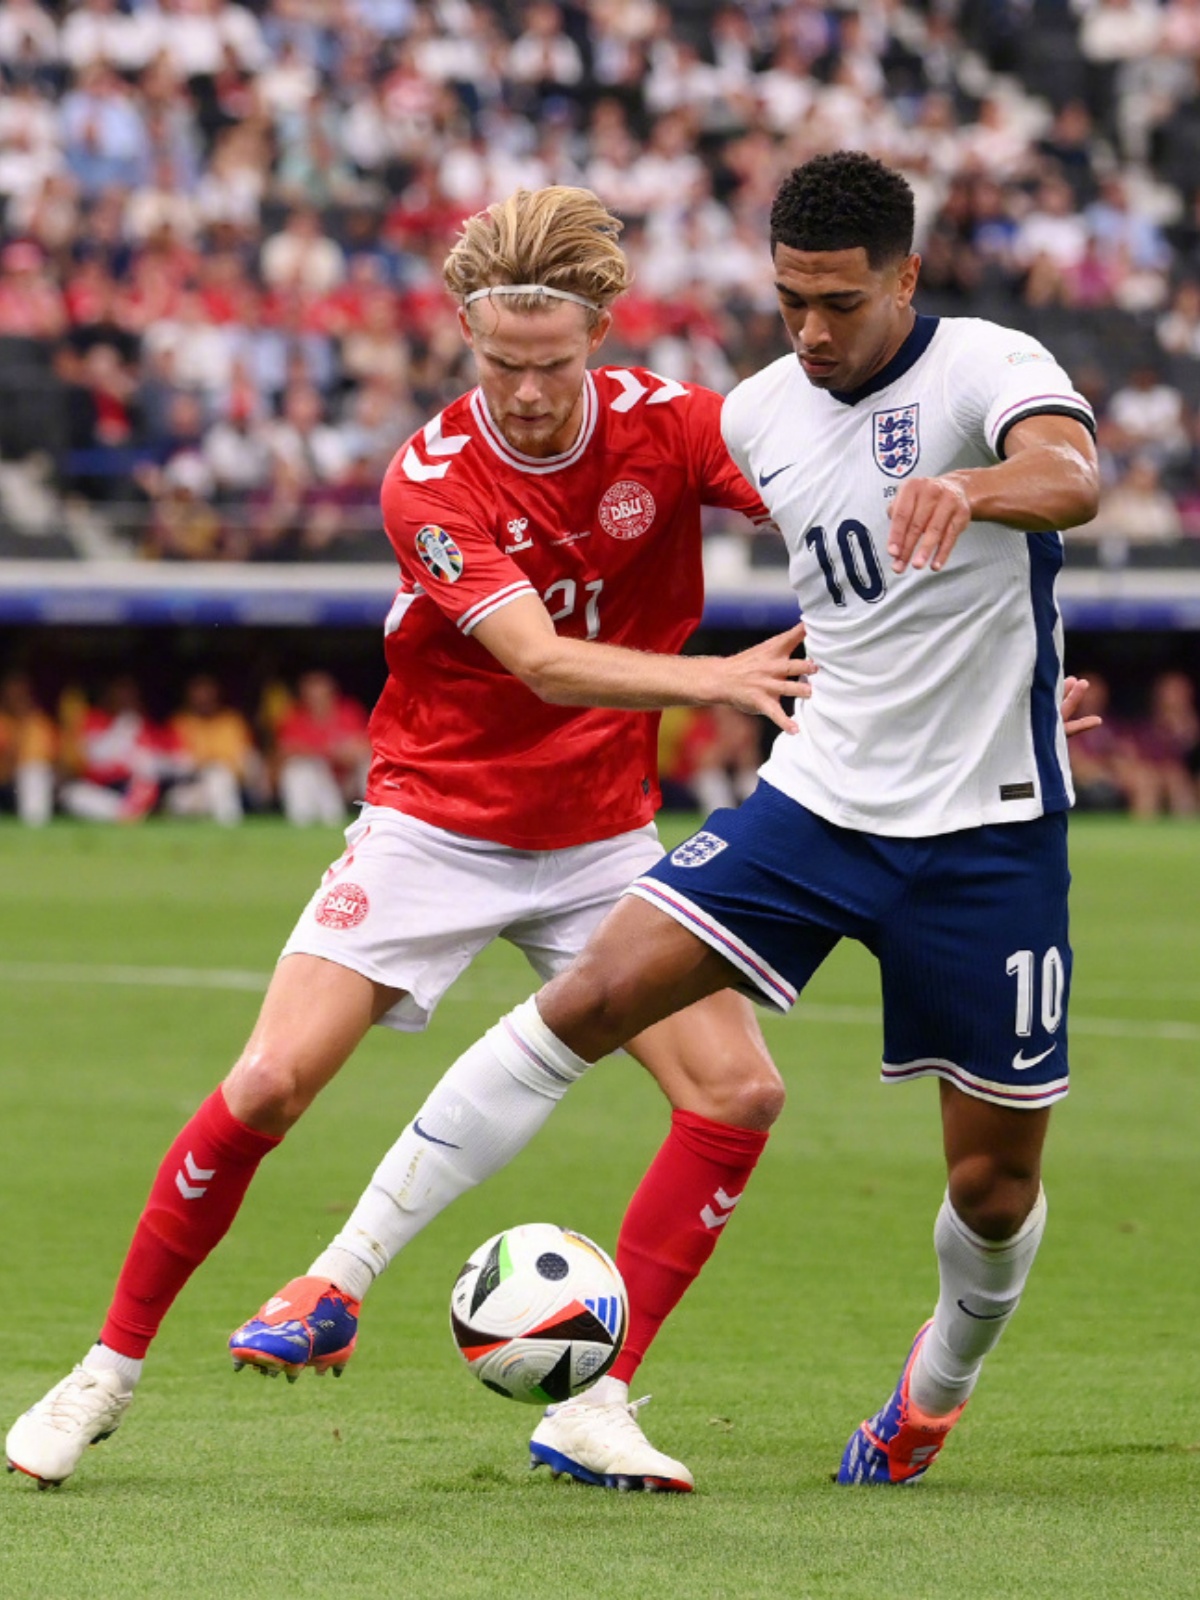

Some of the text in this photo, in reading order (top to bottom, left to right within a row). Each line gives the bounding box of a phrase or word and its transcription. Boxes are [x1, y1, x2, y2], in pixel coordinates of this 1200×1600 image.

[610, 497, 643, 521] DBU
[804, 518, 888, 608] 10
[325, 896, 359, 916] DBU
[1006, 946, 1065, 1037] 10
